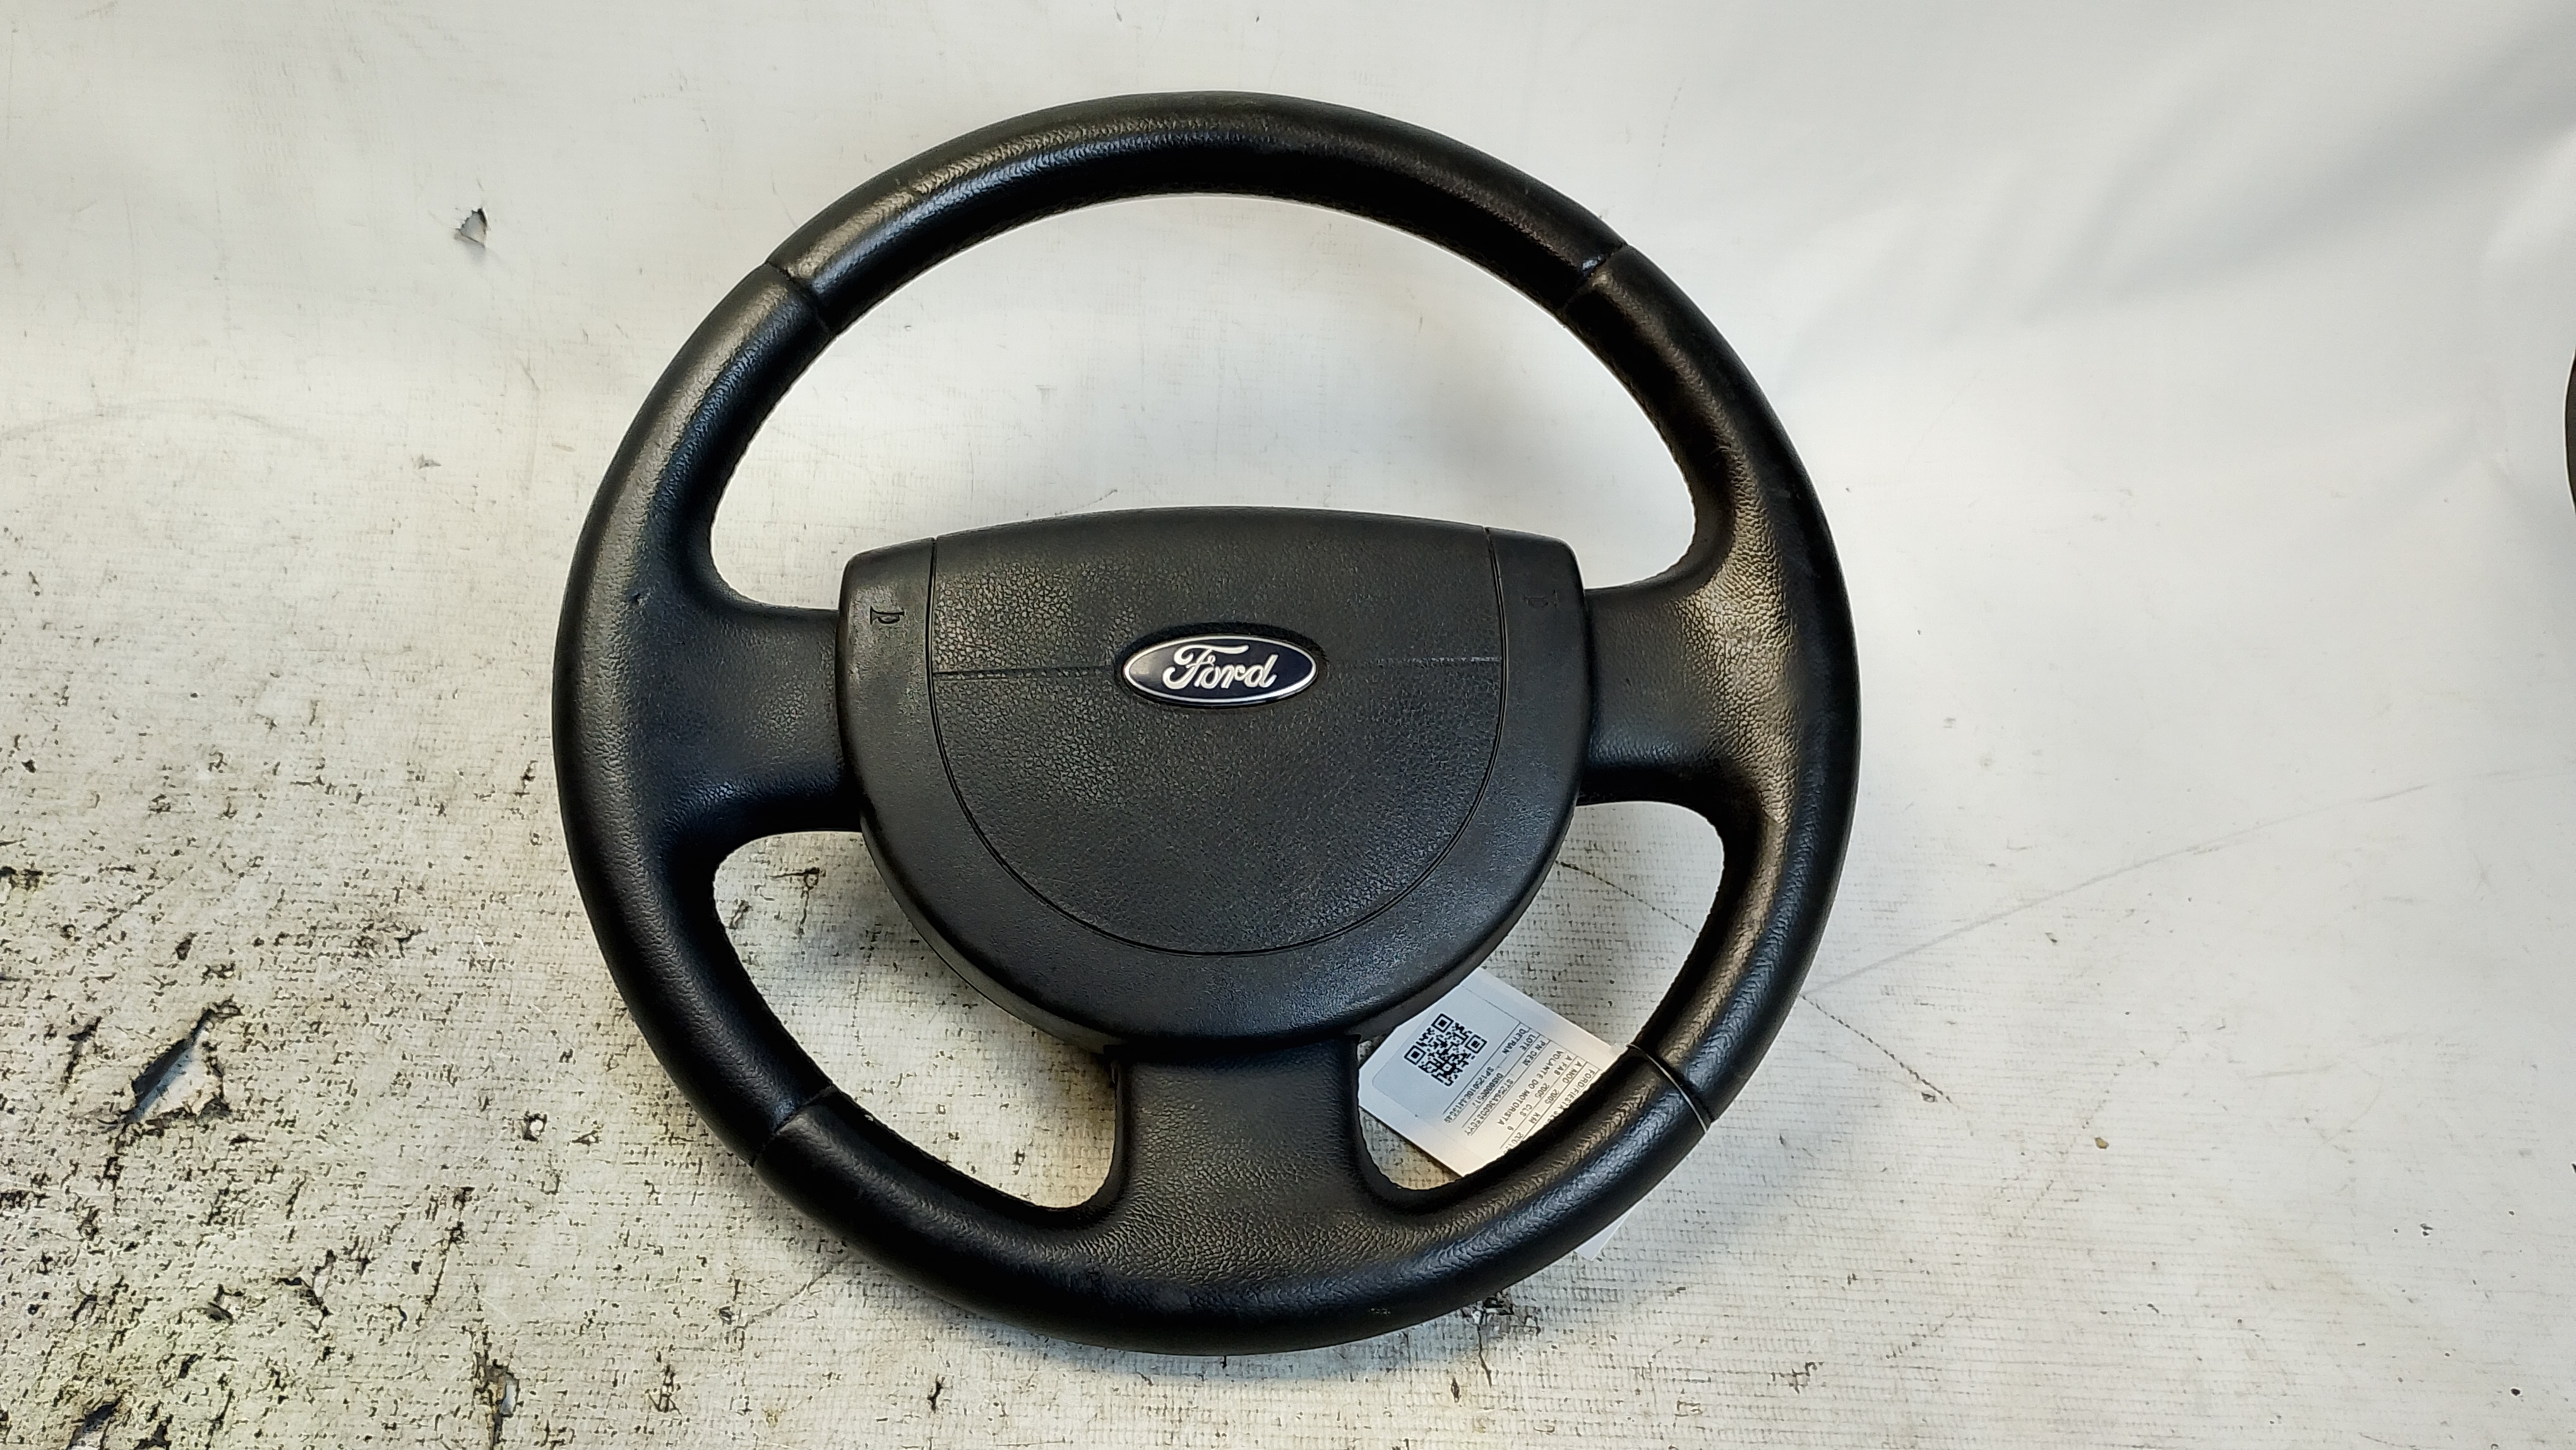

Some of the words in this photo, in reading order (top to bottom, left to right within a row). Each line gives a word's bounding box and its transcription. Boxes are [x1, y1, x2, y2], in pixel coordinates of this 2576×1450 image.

[1162, 644, 1279, 690] Ford
[1500, 1028, 1527, 1055] DETRAN
[1518, 1033, 1536, 1052] LOTE
[1534, 1040, 1546, 1051] PN
[1535, 1049, 1564, 1079] VOLANTE
[1553, 1061, 1568, 1076] FAB
[1574, 1060, 1583, 1069] A
[1526, 1078, 1539, 1090] DO
[1496, 1088, 1531, 1126] MOTORISTA
[1527, 1111, 1541, 1124] KM
